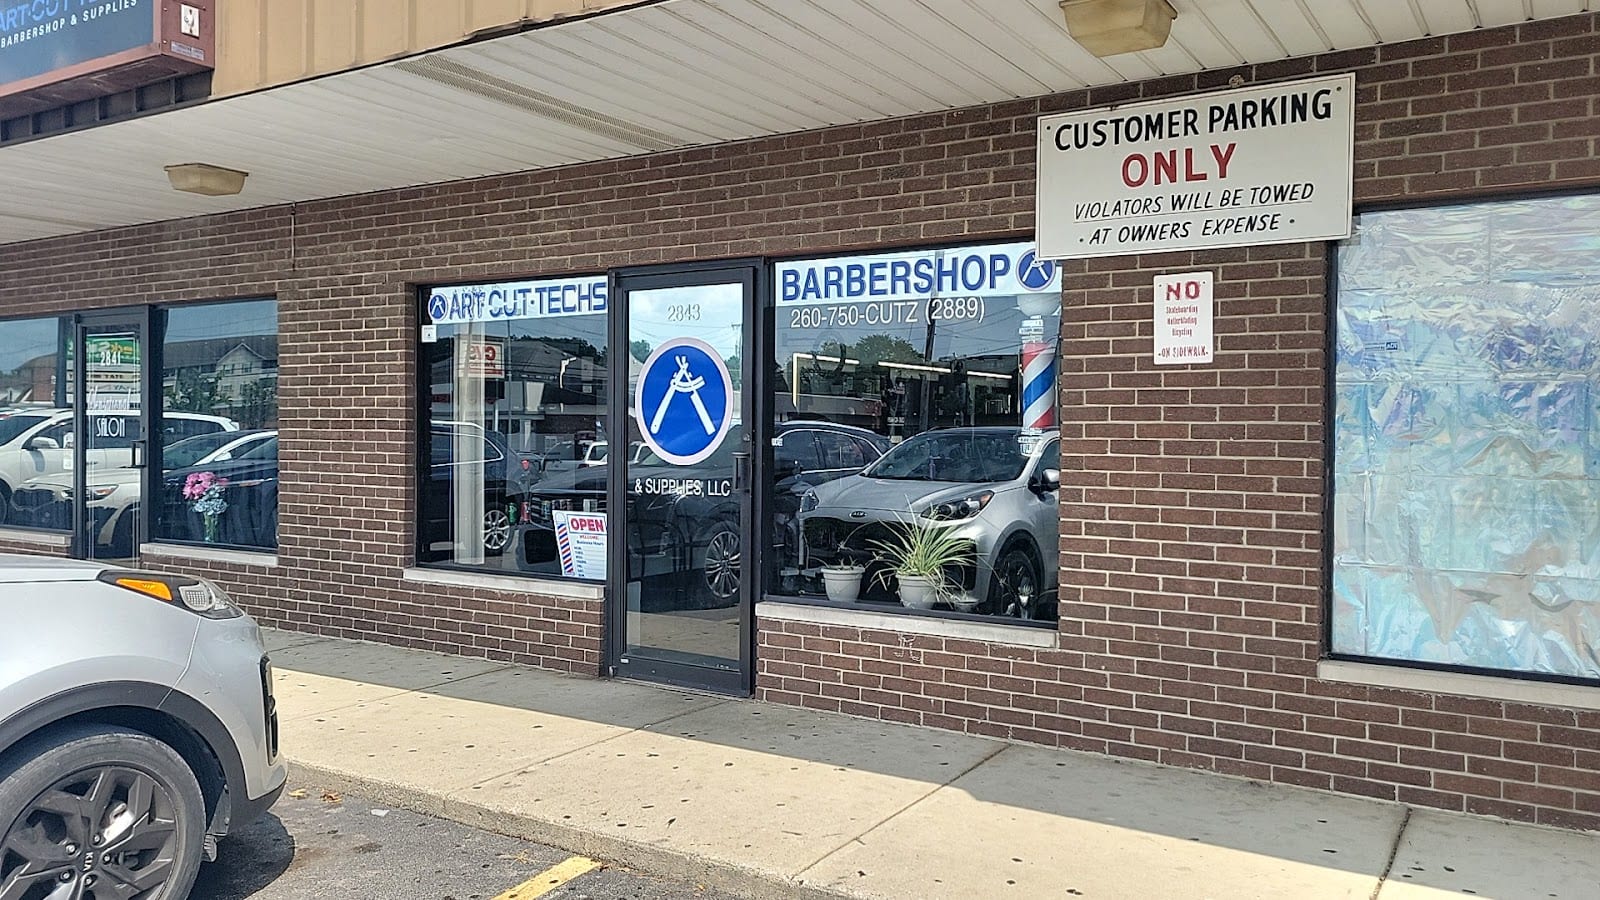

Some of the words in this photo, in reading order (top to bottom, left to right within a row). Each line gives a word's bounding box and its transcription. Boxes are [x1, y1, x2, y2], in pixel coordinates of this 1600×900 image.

[0, 18, 66, 48] BARBERSHOP
[70, 14, 78, 26] &
[82, 0, 137, 22] SUPPLIES
[1054, 108, 1200, 151] CUSTOMER
[1208, 89, 1332, 134] PARKING
[1122, 142, 1237, 188] ONLY
[1074, 196, 1164, 220] VIOLATORS
[1171, 192, 1214, 212] WILL
[1220, 189, 1242, 208] BE
[1250, 183, 1314, 204] TOWED
[1089, 228, 1112, 246] AT
[1118, 221, 1192, 243] OWNERS
[1201, 213, 1281, 237] EXPENSE
[781, 253, 1011, 301] BARBERSHOP
[1166, 281, 1200, 301] NO
[667, 303, 701, 322] 2843
[790, 301, 919, 329] 260-750-CUTZ
[925, 295, 986, 325] (2889)
[100, 351, 121, 366] 2841
[1172, 345, 1206, 358] SIDEWALK
[96, 417, 126, 437] SALON
[634, 478, 643, 495] &
[645, 478, 705, 498] SUPPLIES,
[707, 480, 731, 497] LLC
[570, 518, 604, 532] OPEN
[83, 852, 93, 871] KIA
